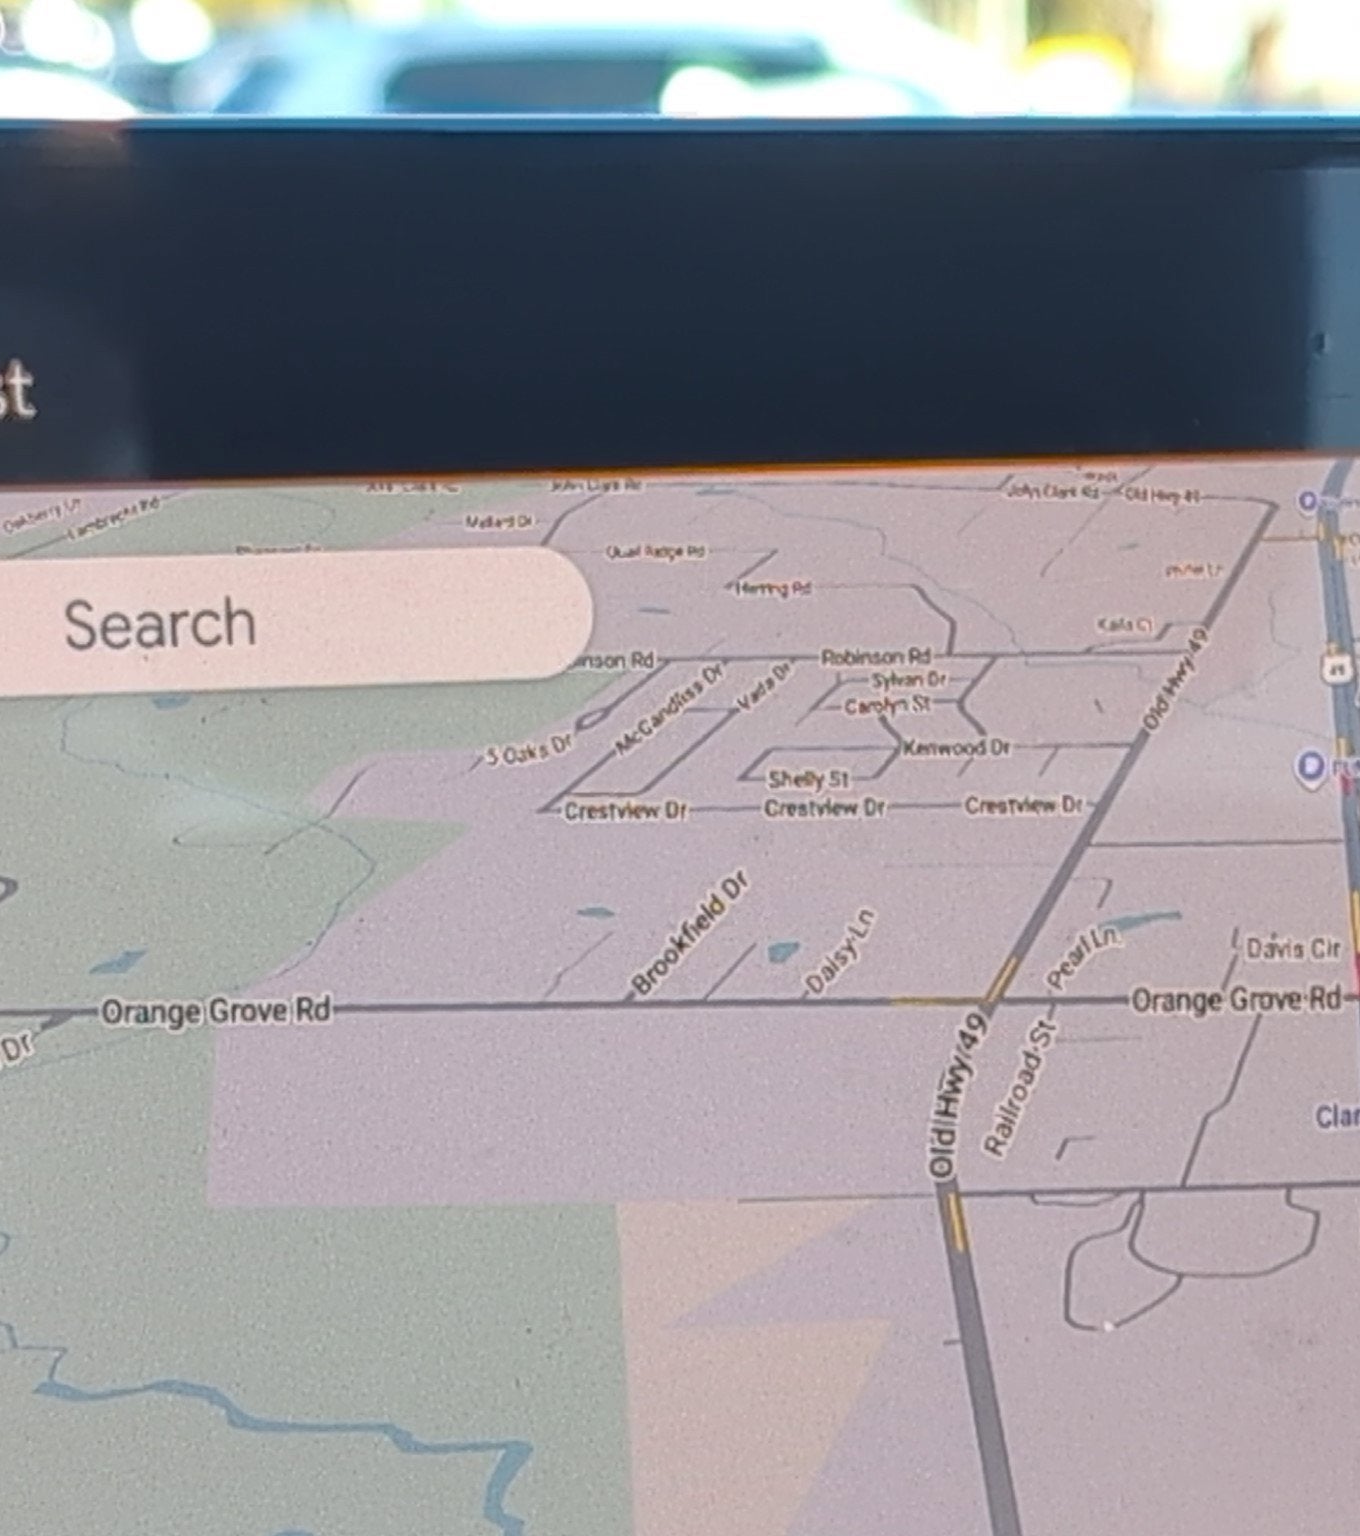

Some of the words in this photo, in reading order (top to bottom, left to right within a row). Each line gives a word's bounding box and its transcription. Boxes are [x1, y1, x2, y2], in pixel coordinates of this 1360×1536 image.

[65, 594, 256, 651] Search
[631, 651, 655, 669] Rd
[821, 648, 906, 666] Robinson
[908, 648, 932, 665] Rd
[701, 662, 725, 686] Dr
[928, 670, 947, 687] Dr
[912, 694, 931, 712] St
[1142, 692, 1171, 733] Old
[1163, 650, 1197, 698] Hwy
[551, 732, 572, 753] Dr
[902, 739, 986, 756] Kenwood
[989, 738, 1011, 755] Dr
[768, 770, 825, 792] Shelly
[828, 770, 849, 787] St
[564, 802, 661, 820] Crestview
[665, 802, 688, 820] Dr
[764, 799, 858, 817] Crestview
[863, 798, 886, 817] Dr
[965, 797, 1056, 815] Crestview
[1061, 795, 1083, 813] Dr
[630, 893, 726, 996] Brookfield
[721, 869, 749, 901] Dr
[805, 940, 860, 995] Daisy
[847, 909, 875, 940] Ln
[1047, 936, 1092, 990] Pearl
[1090, 928, 1118, 949] Ln
[1247, 937, 1305, 960] Davis
[1311, 937, 1341, 959] Cir
[101, 999, 200, 1029] Orange
[209, 997, 288, 1026] Grove
[296, 996, 332, 1024] Rd
[1132, 987, 1223, 1016] Orange
[1230, 987, 1302, 1012] Grove
[1308, 985, 1343, 1010] Rd
[958, 1011, 988, 1053] 49
[0, 1032, 33, 1064] Dr
[935, 1055, 974, 1120] Hwy
[984, 1050, 1043, 1157] Railroad
[1029, 1020, 1056, 1050] St
[929, 1126, 956, 1178] Old
